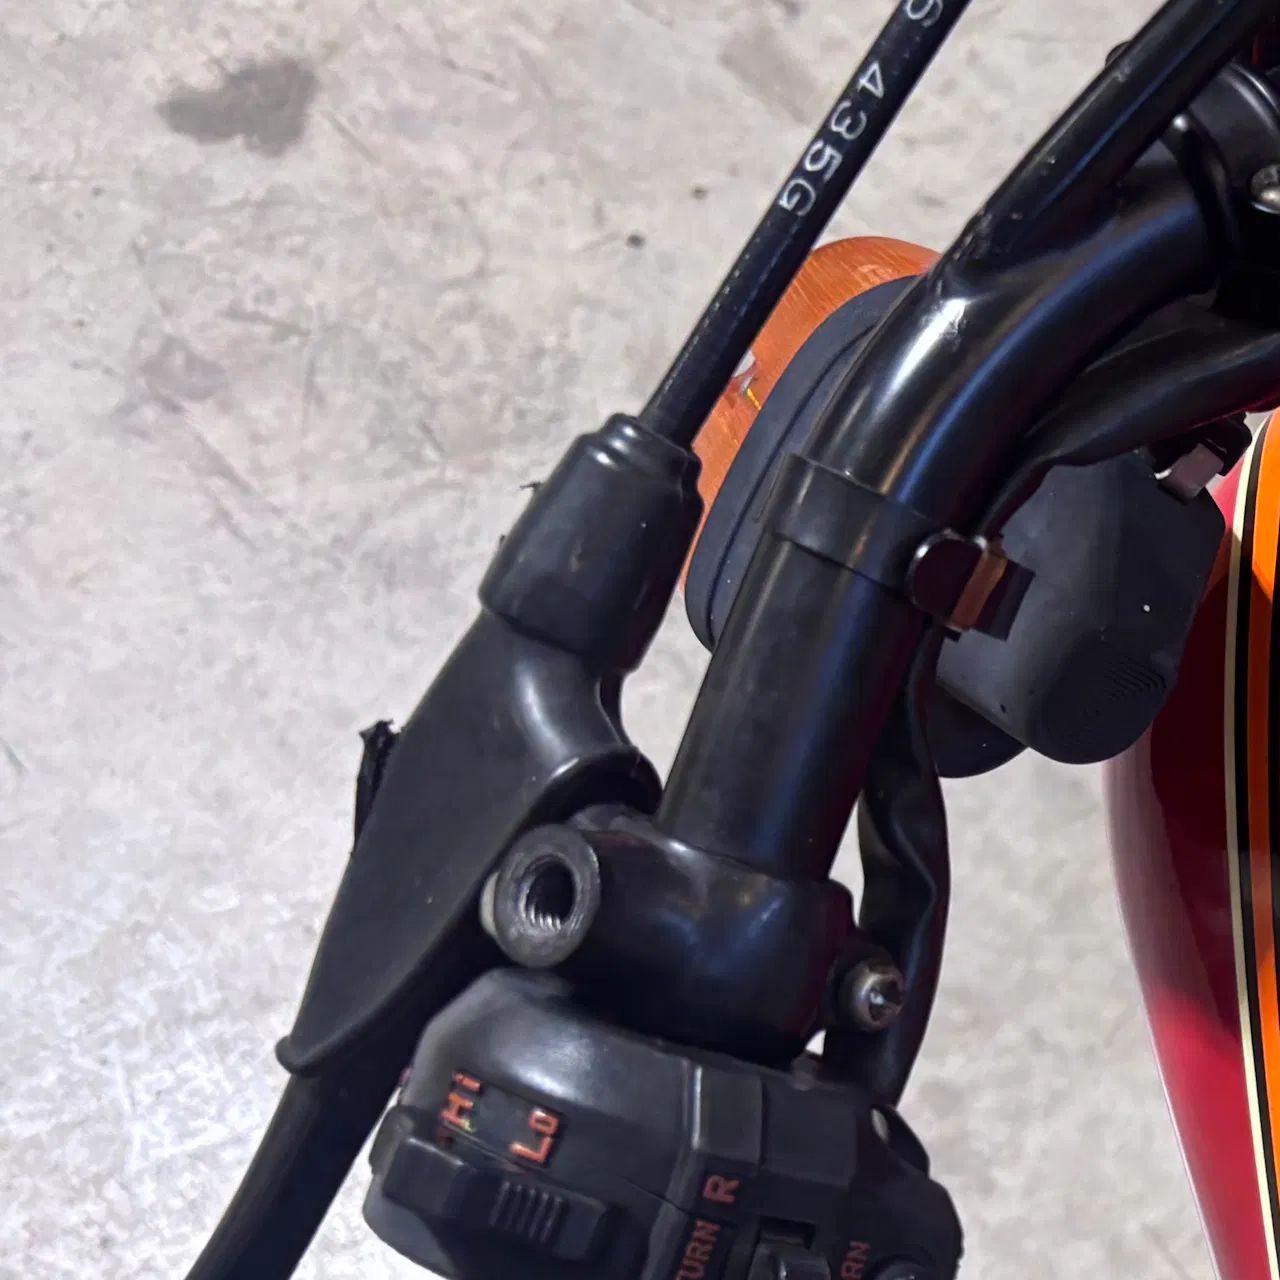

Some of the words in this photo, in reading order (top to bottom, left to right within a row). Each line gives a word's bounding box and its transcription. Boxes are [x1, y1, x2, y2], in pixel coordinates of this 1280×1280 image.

[778, 60, 885, 216] 435G
[440, 1072, 480, 1133] Hi
[509, 1108, 559, 1163] Lo
[703, 1174, 740, 1204] R
